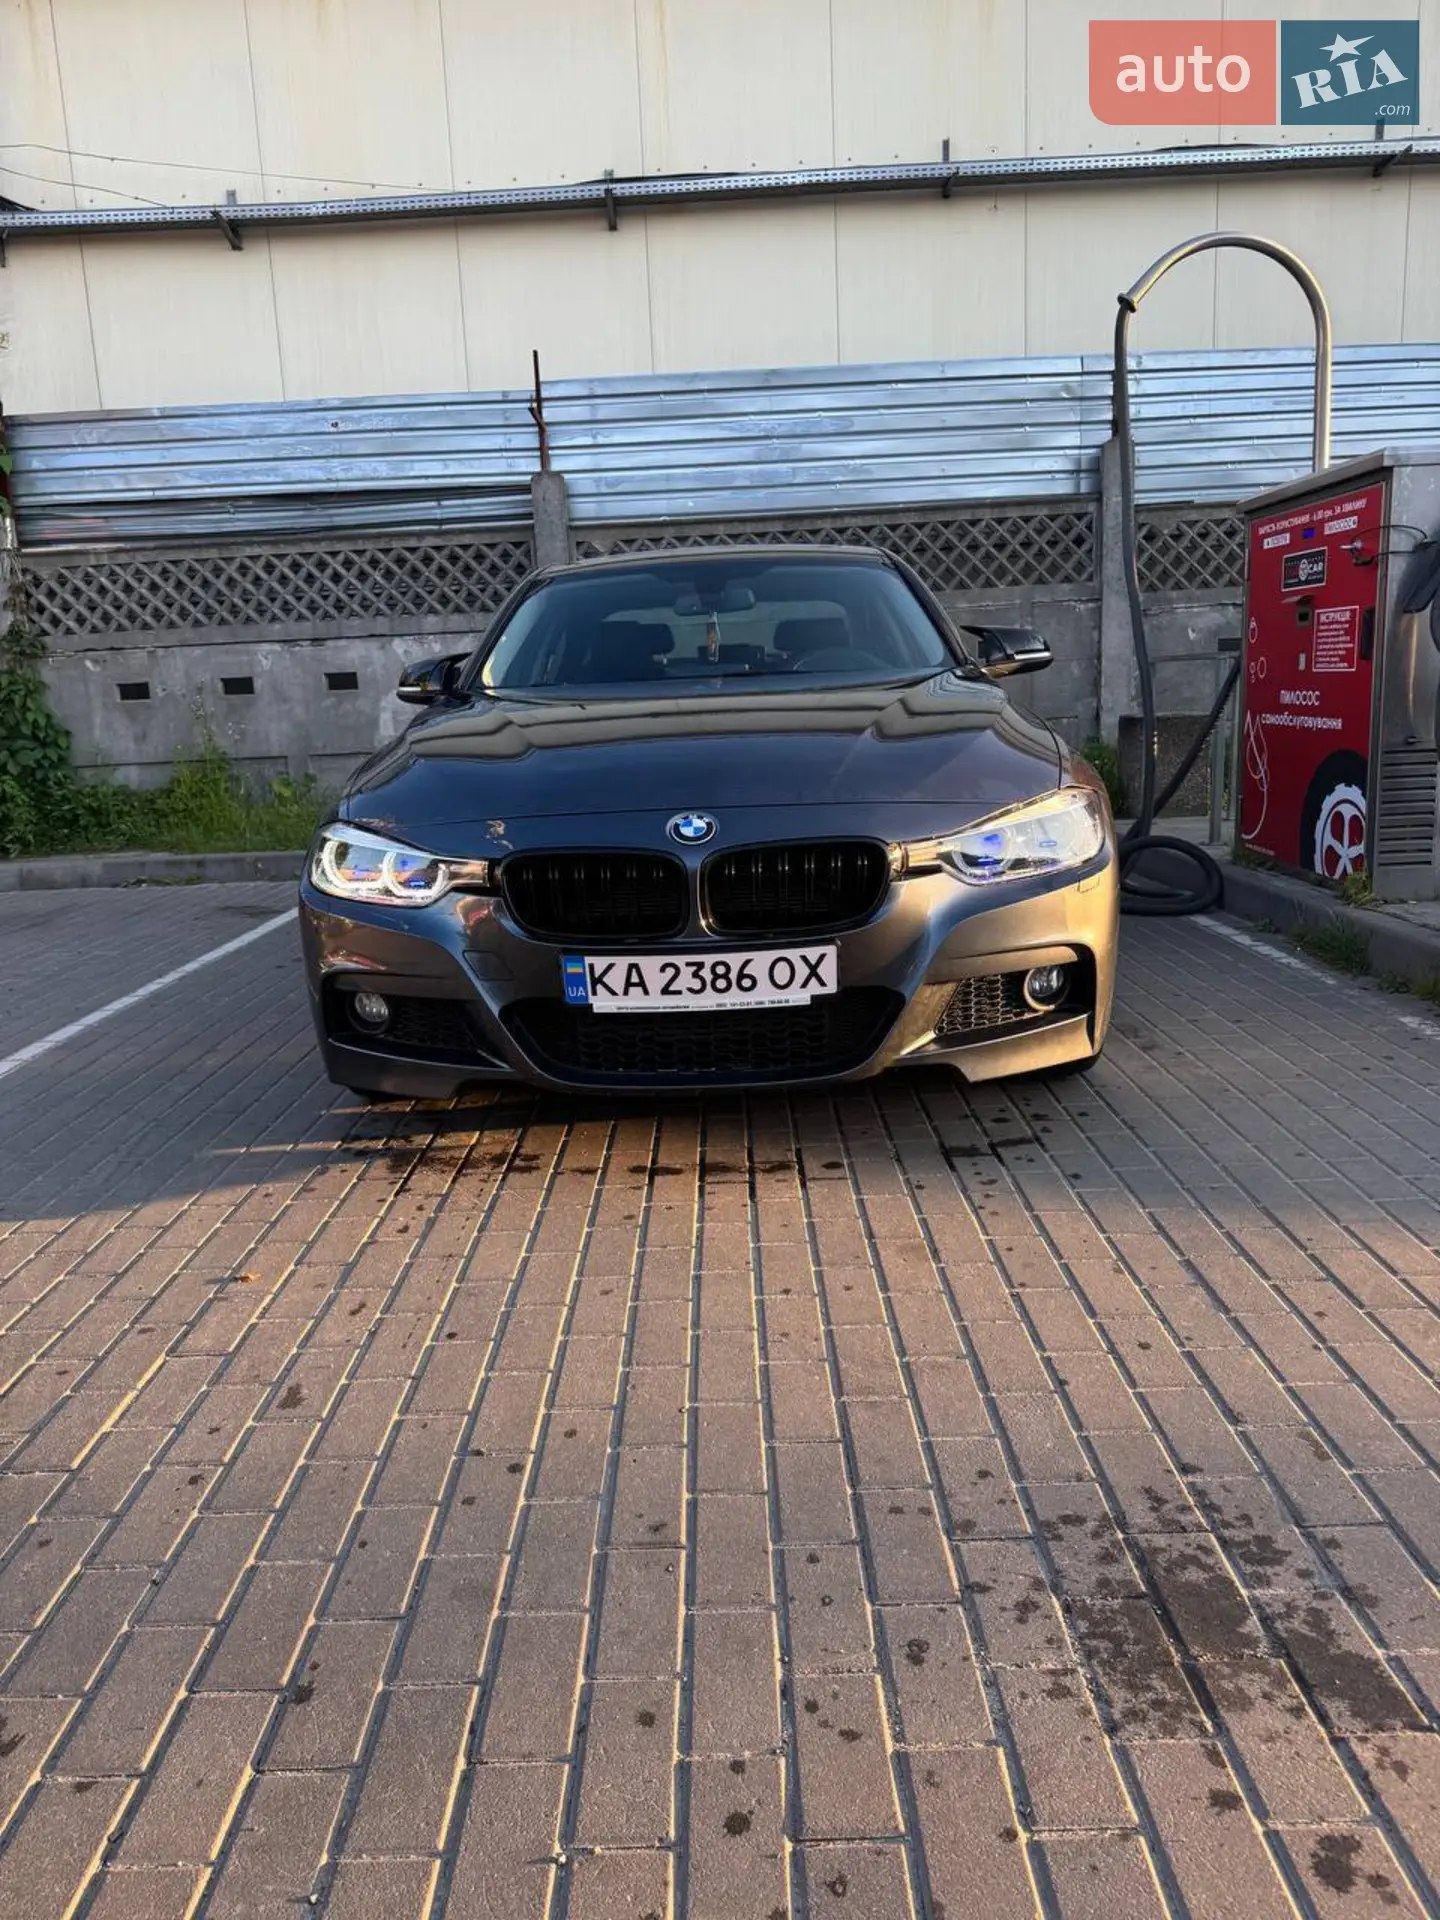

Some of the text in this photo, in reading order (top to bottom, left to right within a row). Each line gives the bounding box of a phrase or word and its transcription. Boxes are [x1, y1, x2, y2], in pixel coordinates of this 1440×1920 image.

[1280, 690, 1321, 706] ПИЛОСОС
[1261, 712, 1343, 731] самообслуговування
[588, 952, 828, 998] KA 2386 OX
[568, 985, 587, 998] UA
